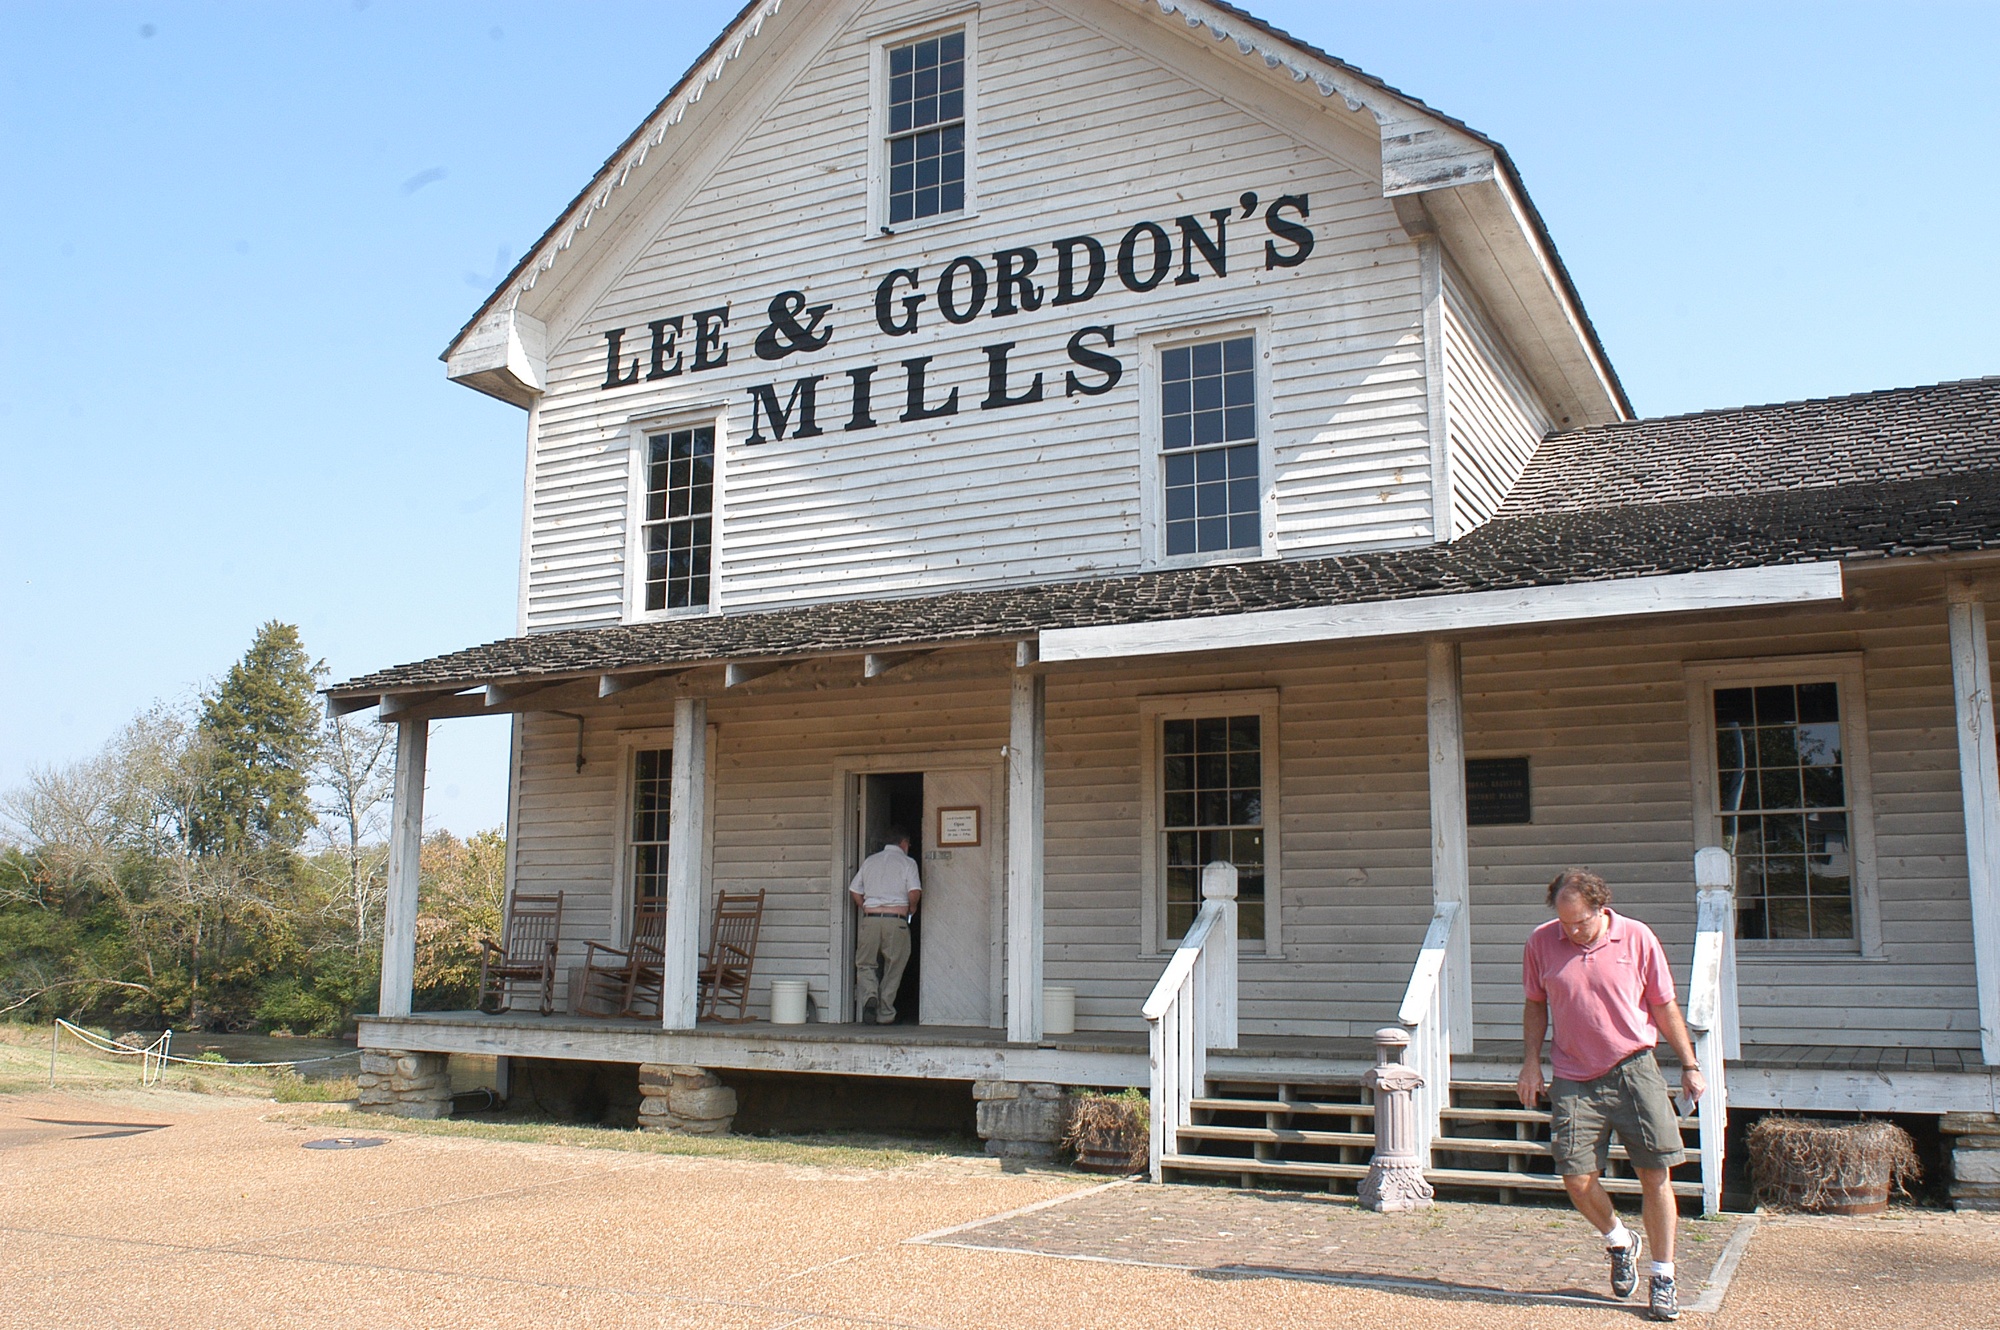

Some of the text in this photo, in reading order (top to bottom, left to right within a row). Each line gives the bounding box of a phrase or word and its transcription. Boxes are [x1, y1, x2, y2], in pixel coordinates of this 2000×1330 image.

[601, 191, 1315, 391] LEE & GORDON'S
[745, 325, 1123, 447] MILLS
